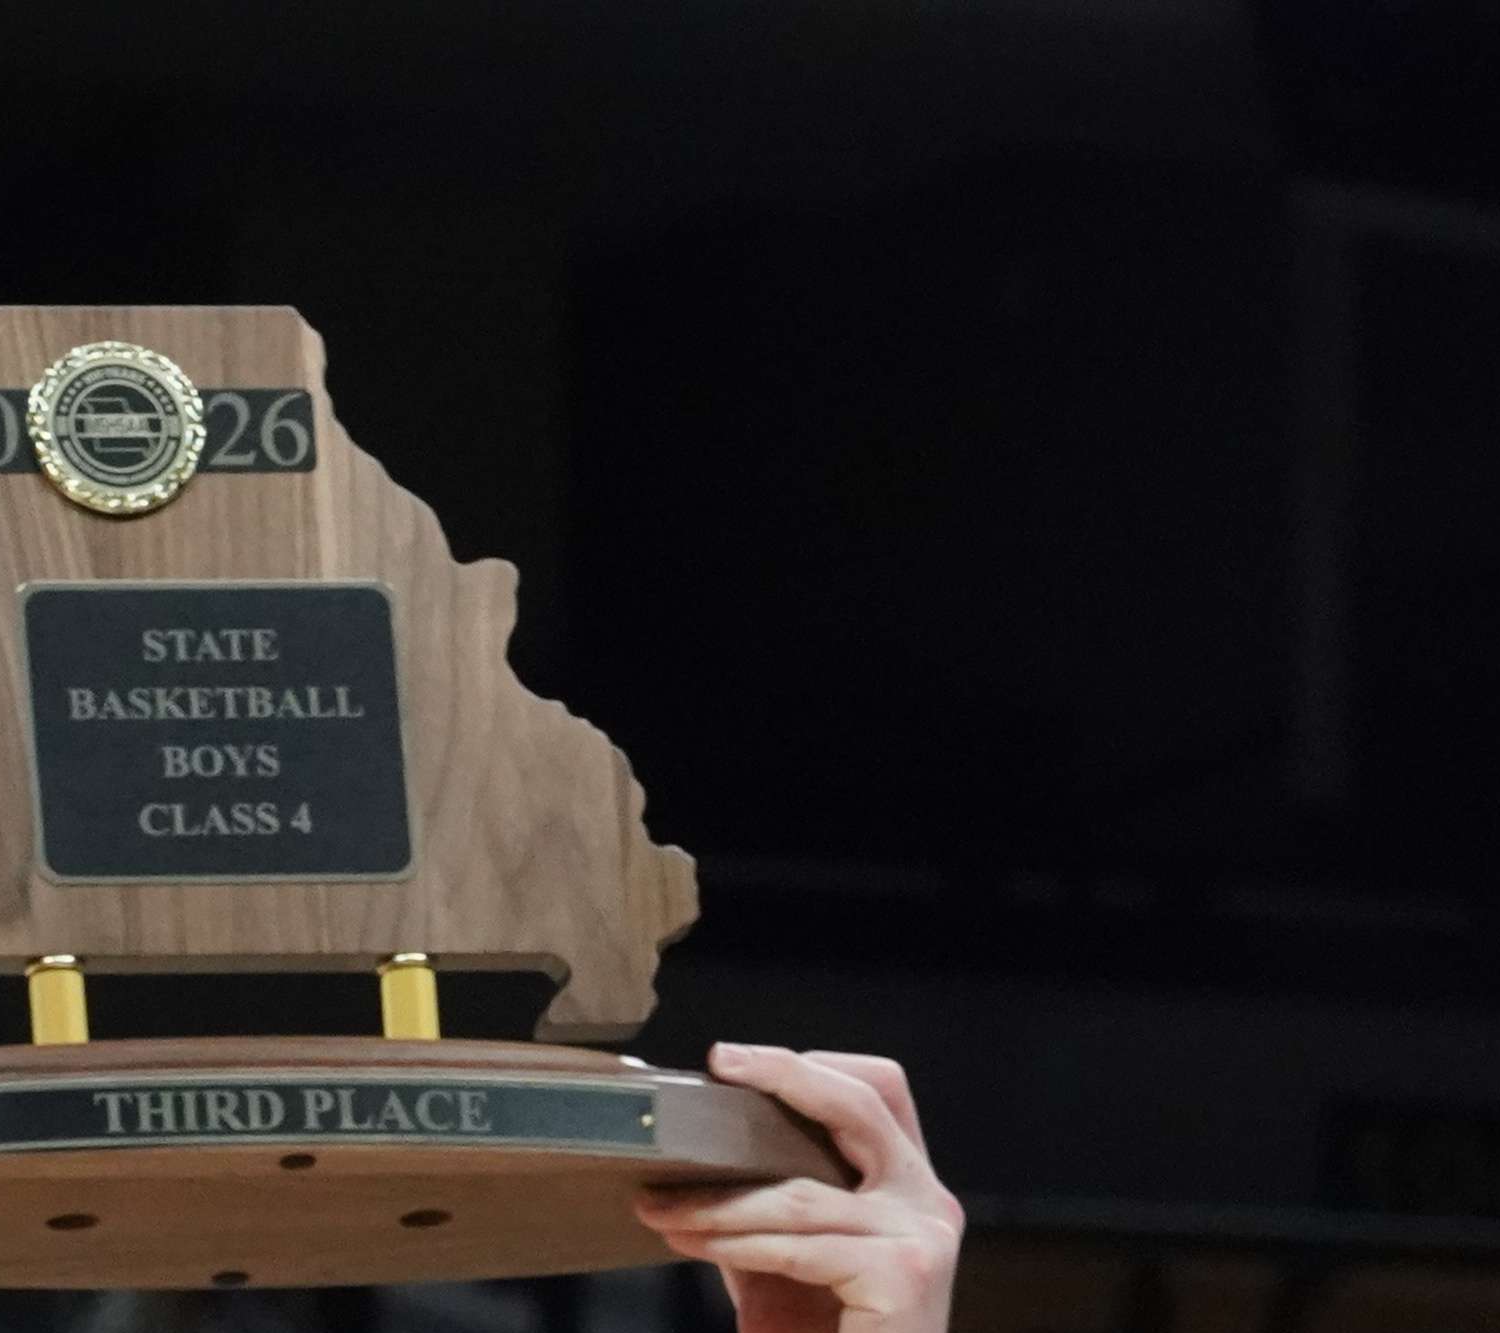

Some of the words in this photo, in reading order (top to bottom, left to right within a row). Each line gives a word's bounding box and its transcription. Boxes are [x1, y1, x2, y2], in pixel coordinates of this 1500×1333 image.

[205, 391, 310, 467] 26
[141, 628, 280, 663] STATE
[67, 685, 366, 721] BASKETBALL
[161, 744, 281, 779] BOYS
[137, 801, 281, 837] CLASS
[289, 801, 313, 835] 4
[93, 1087, 287, 1135] THIRD
[303, 1087, 493, 1133] PLACE
